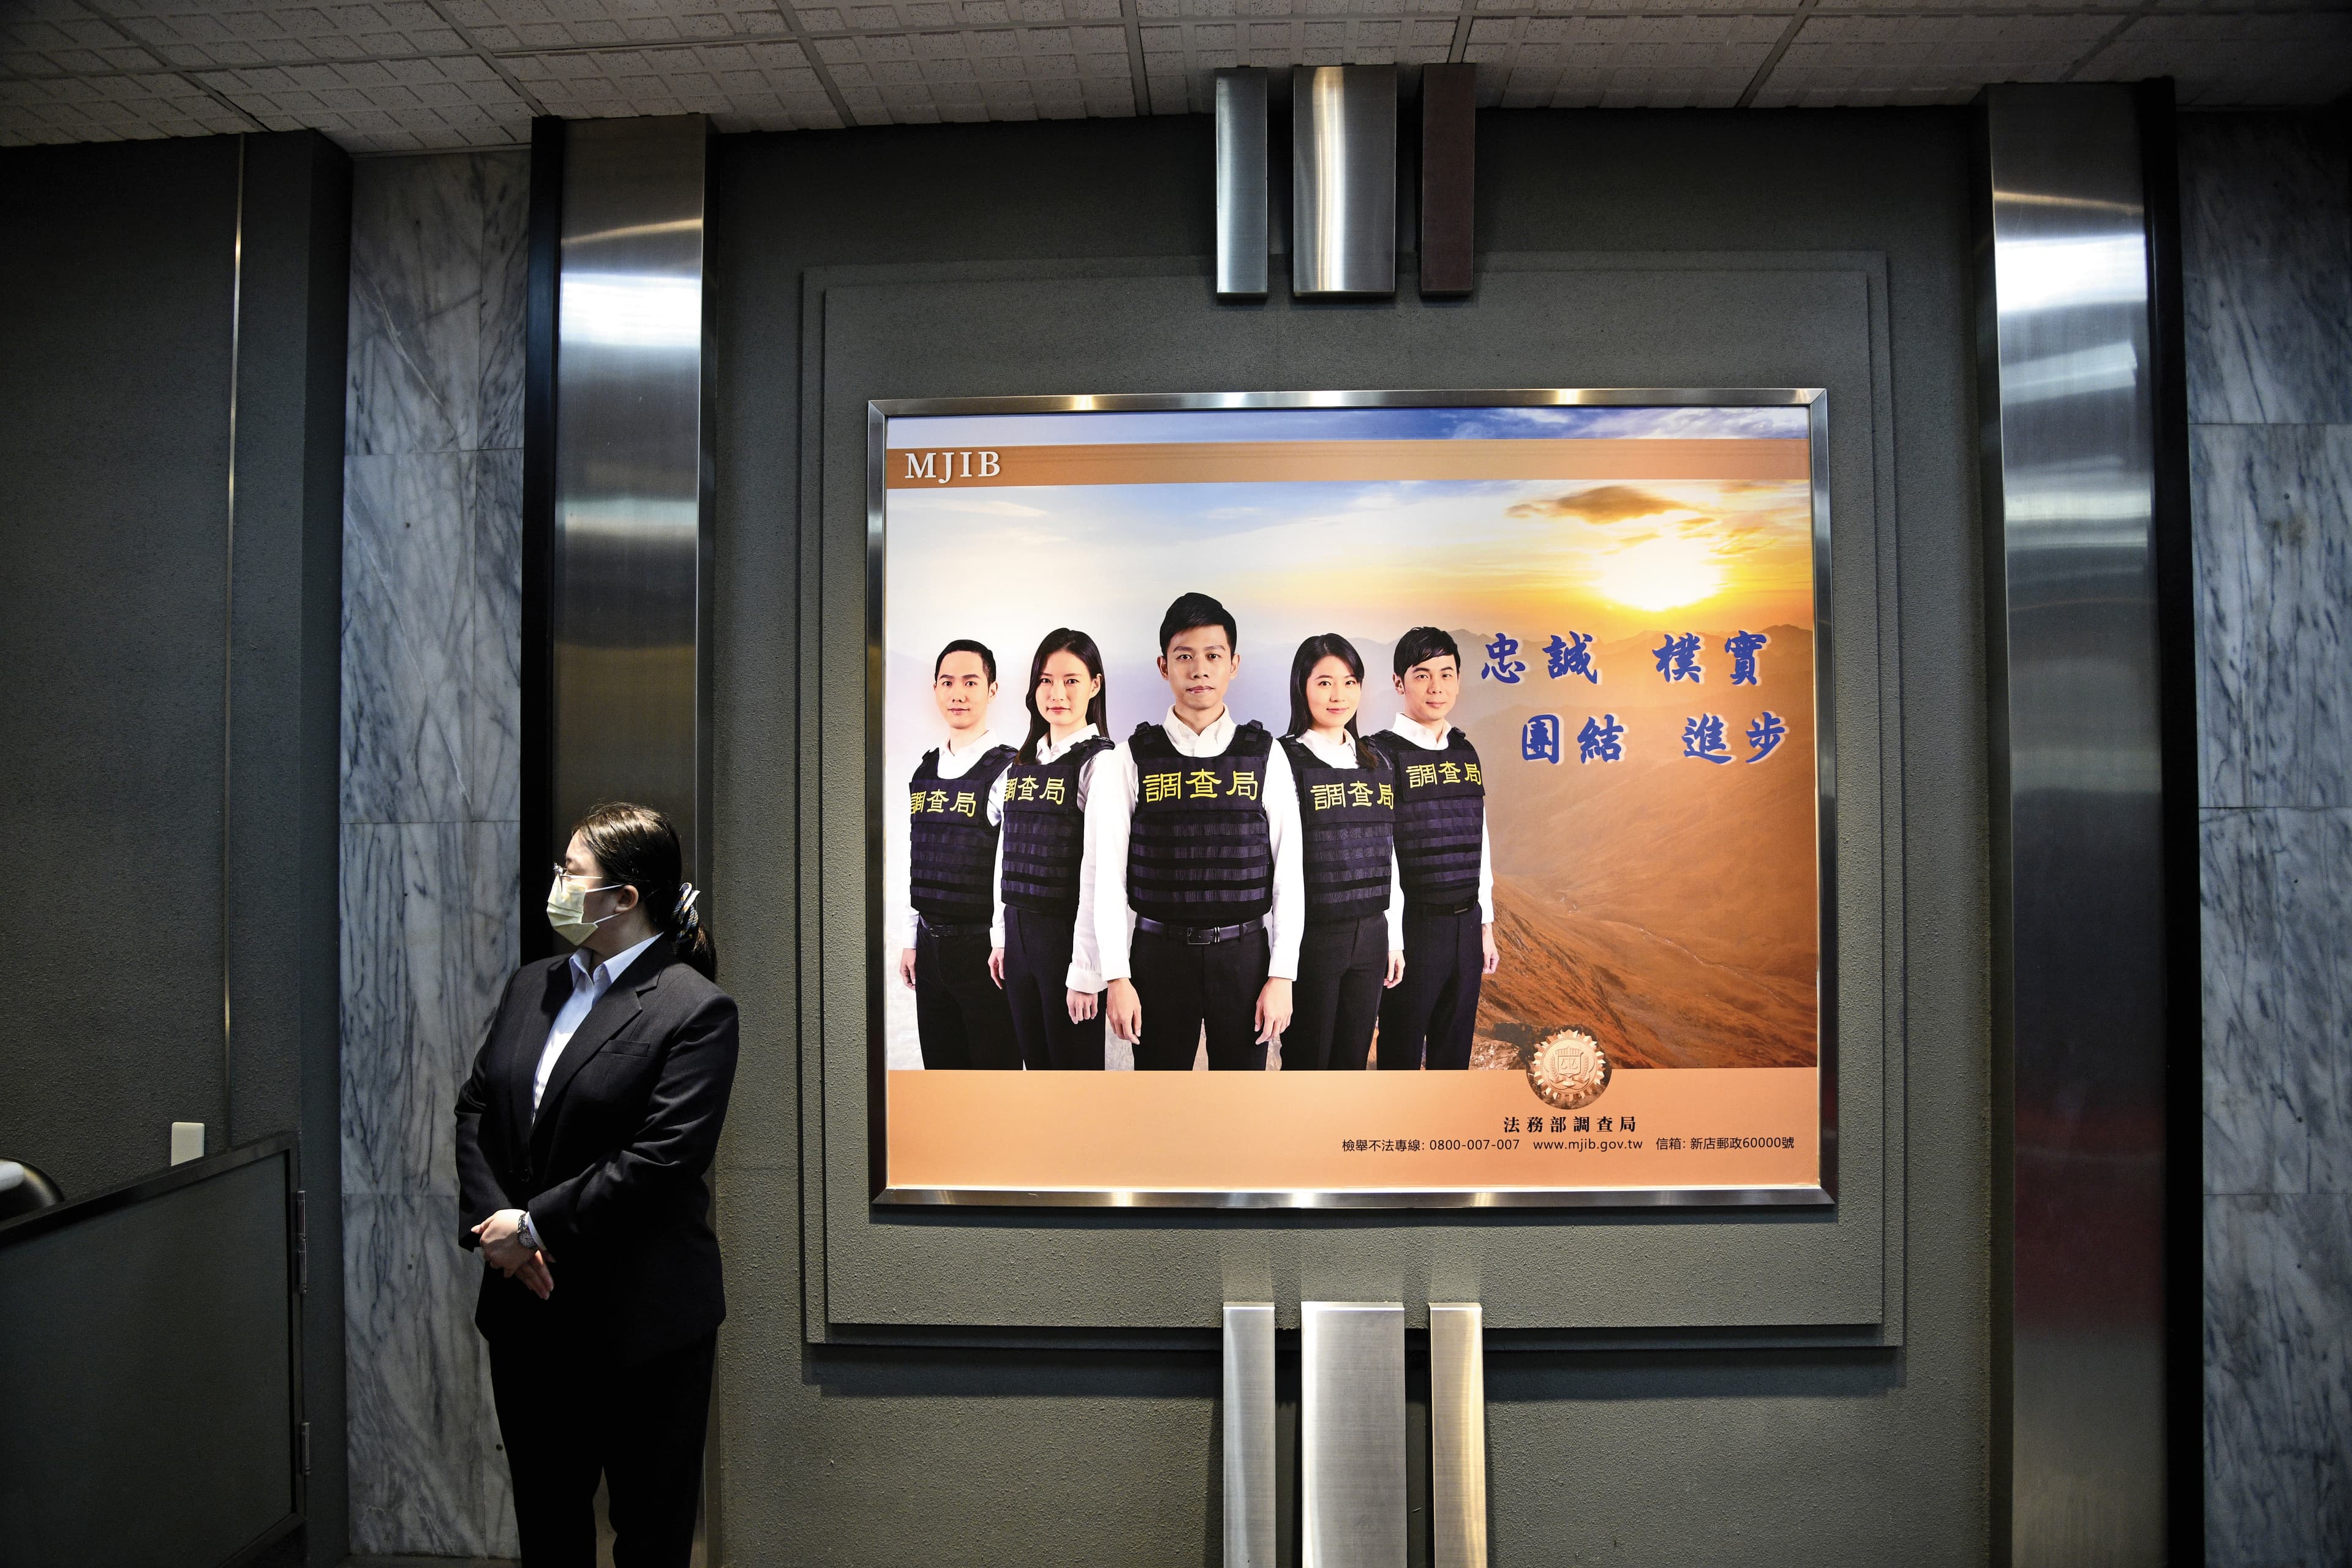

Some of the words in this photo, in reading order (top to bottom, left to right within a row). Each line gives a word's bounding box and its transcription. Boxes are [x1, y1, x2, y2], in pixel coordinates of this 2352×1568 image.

[905, 451, 1000, 484] MJIB
[1481, 630, 1597, 684] 忠誠
[1652, 630, 1767, 685] 樸實
[1521, 714, 1624, 764] 團結
[1681, 712, 1785, 764] 進步
[1142, 768, 1258, 803] 調查局
[1405, 761, 1481, 789] 調查局
[910, 788, 976, 818] 調查局
[1310, 780, 1394, 810] 調查局
[1503, 1116, 1636, 1133] 法務部調查局
[1342, 1139, 1425, 1152] 檢舉不法專線:
[1429, 1139, 1520, 1150] 0800-007-007
[1533, 1139, 1643, 1152] www.mjib.gov.tw
[1656, 1137, 1686, 1150] 信箱:
[1690, 1137, 1795, 1150] 新店郵政60000號
